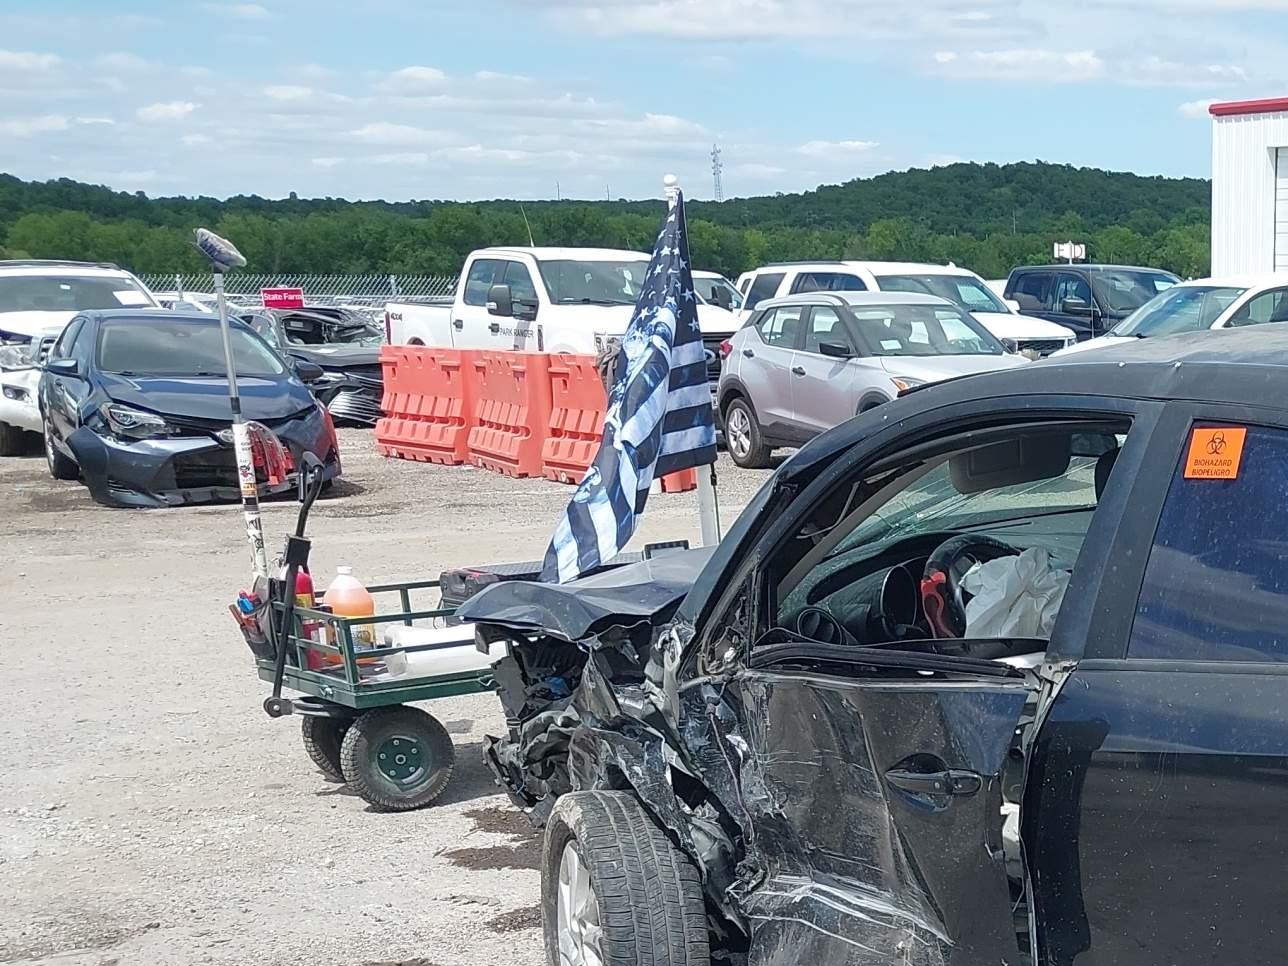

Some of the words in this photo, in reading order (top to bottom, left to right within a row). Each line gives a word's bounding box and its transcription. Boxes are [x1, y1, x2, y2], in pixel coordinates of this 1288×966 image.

[263, 292, 282, 301] State
[283, 292, 302, 301] Farm
[499, 327, 513, 337] PARK
[513, 328, 534, 338] RANGER
[1194, 459, 1232, 467] BIOHAZARD
